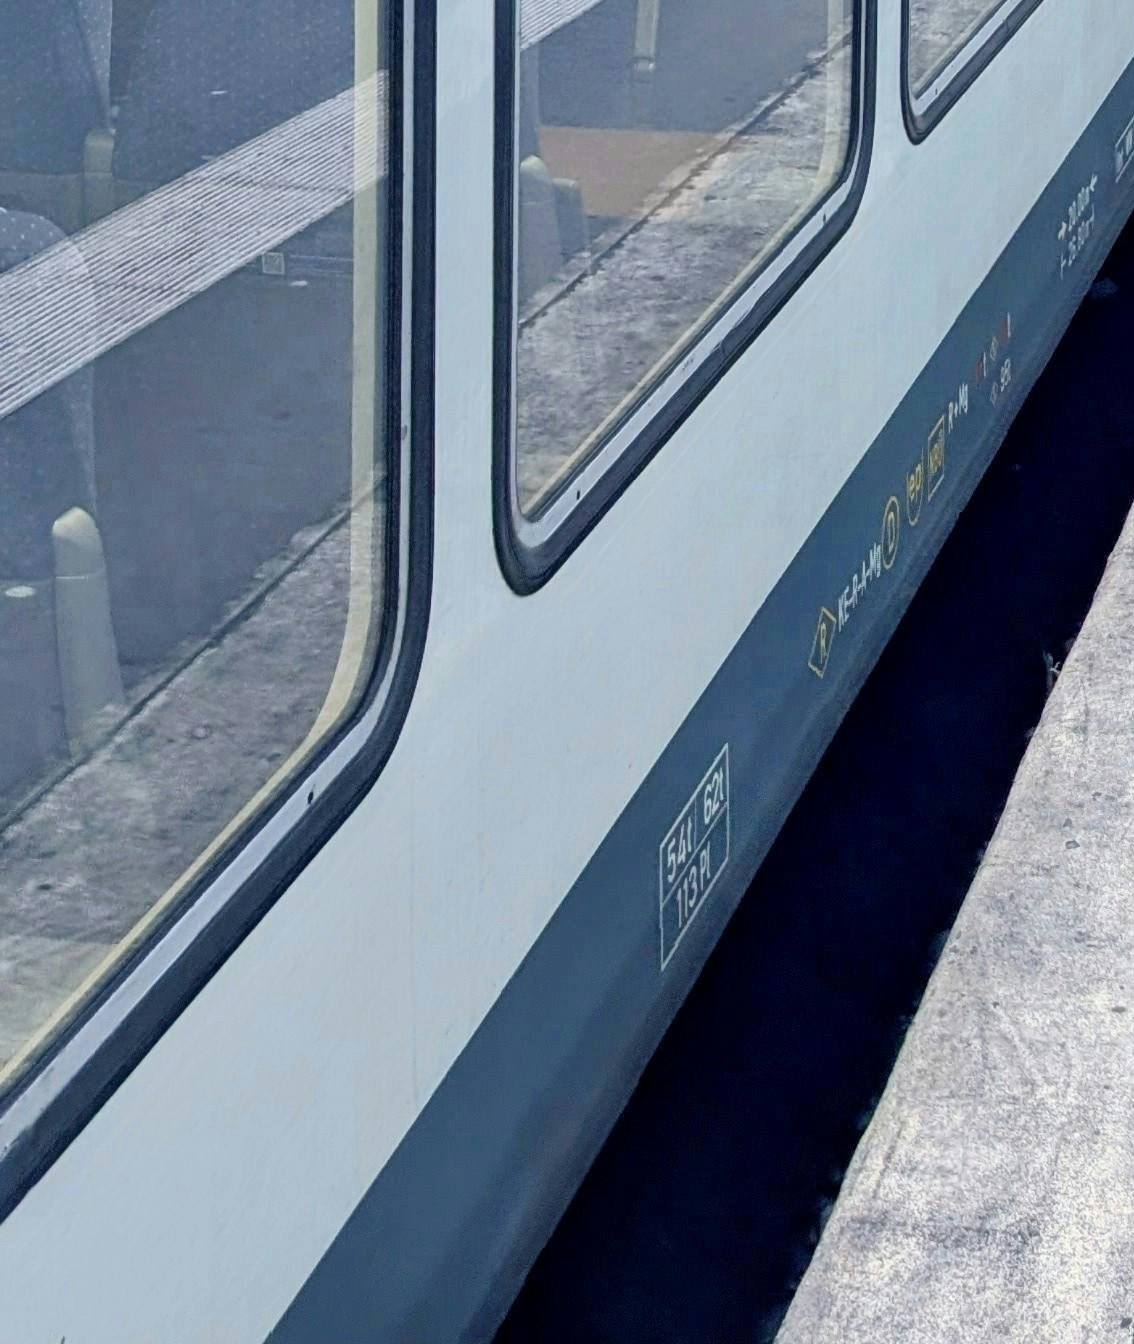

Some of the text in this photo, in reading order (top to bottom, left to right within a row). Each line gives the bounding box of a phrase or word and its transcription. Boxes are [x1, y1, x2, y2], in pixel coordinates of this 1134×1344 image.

[666, 766, 725, 884] 54t 62t
[675, 864, 698, 930] 113
